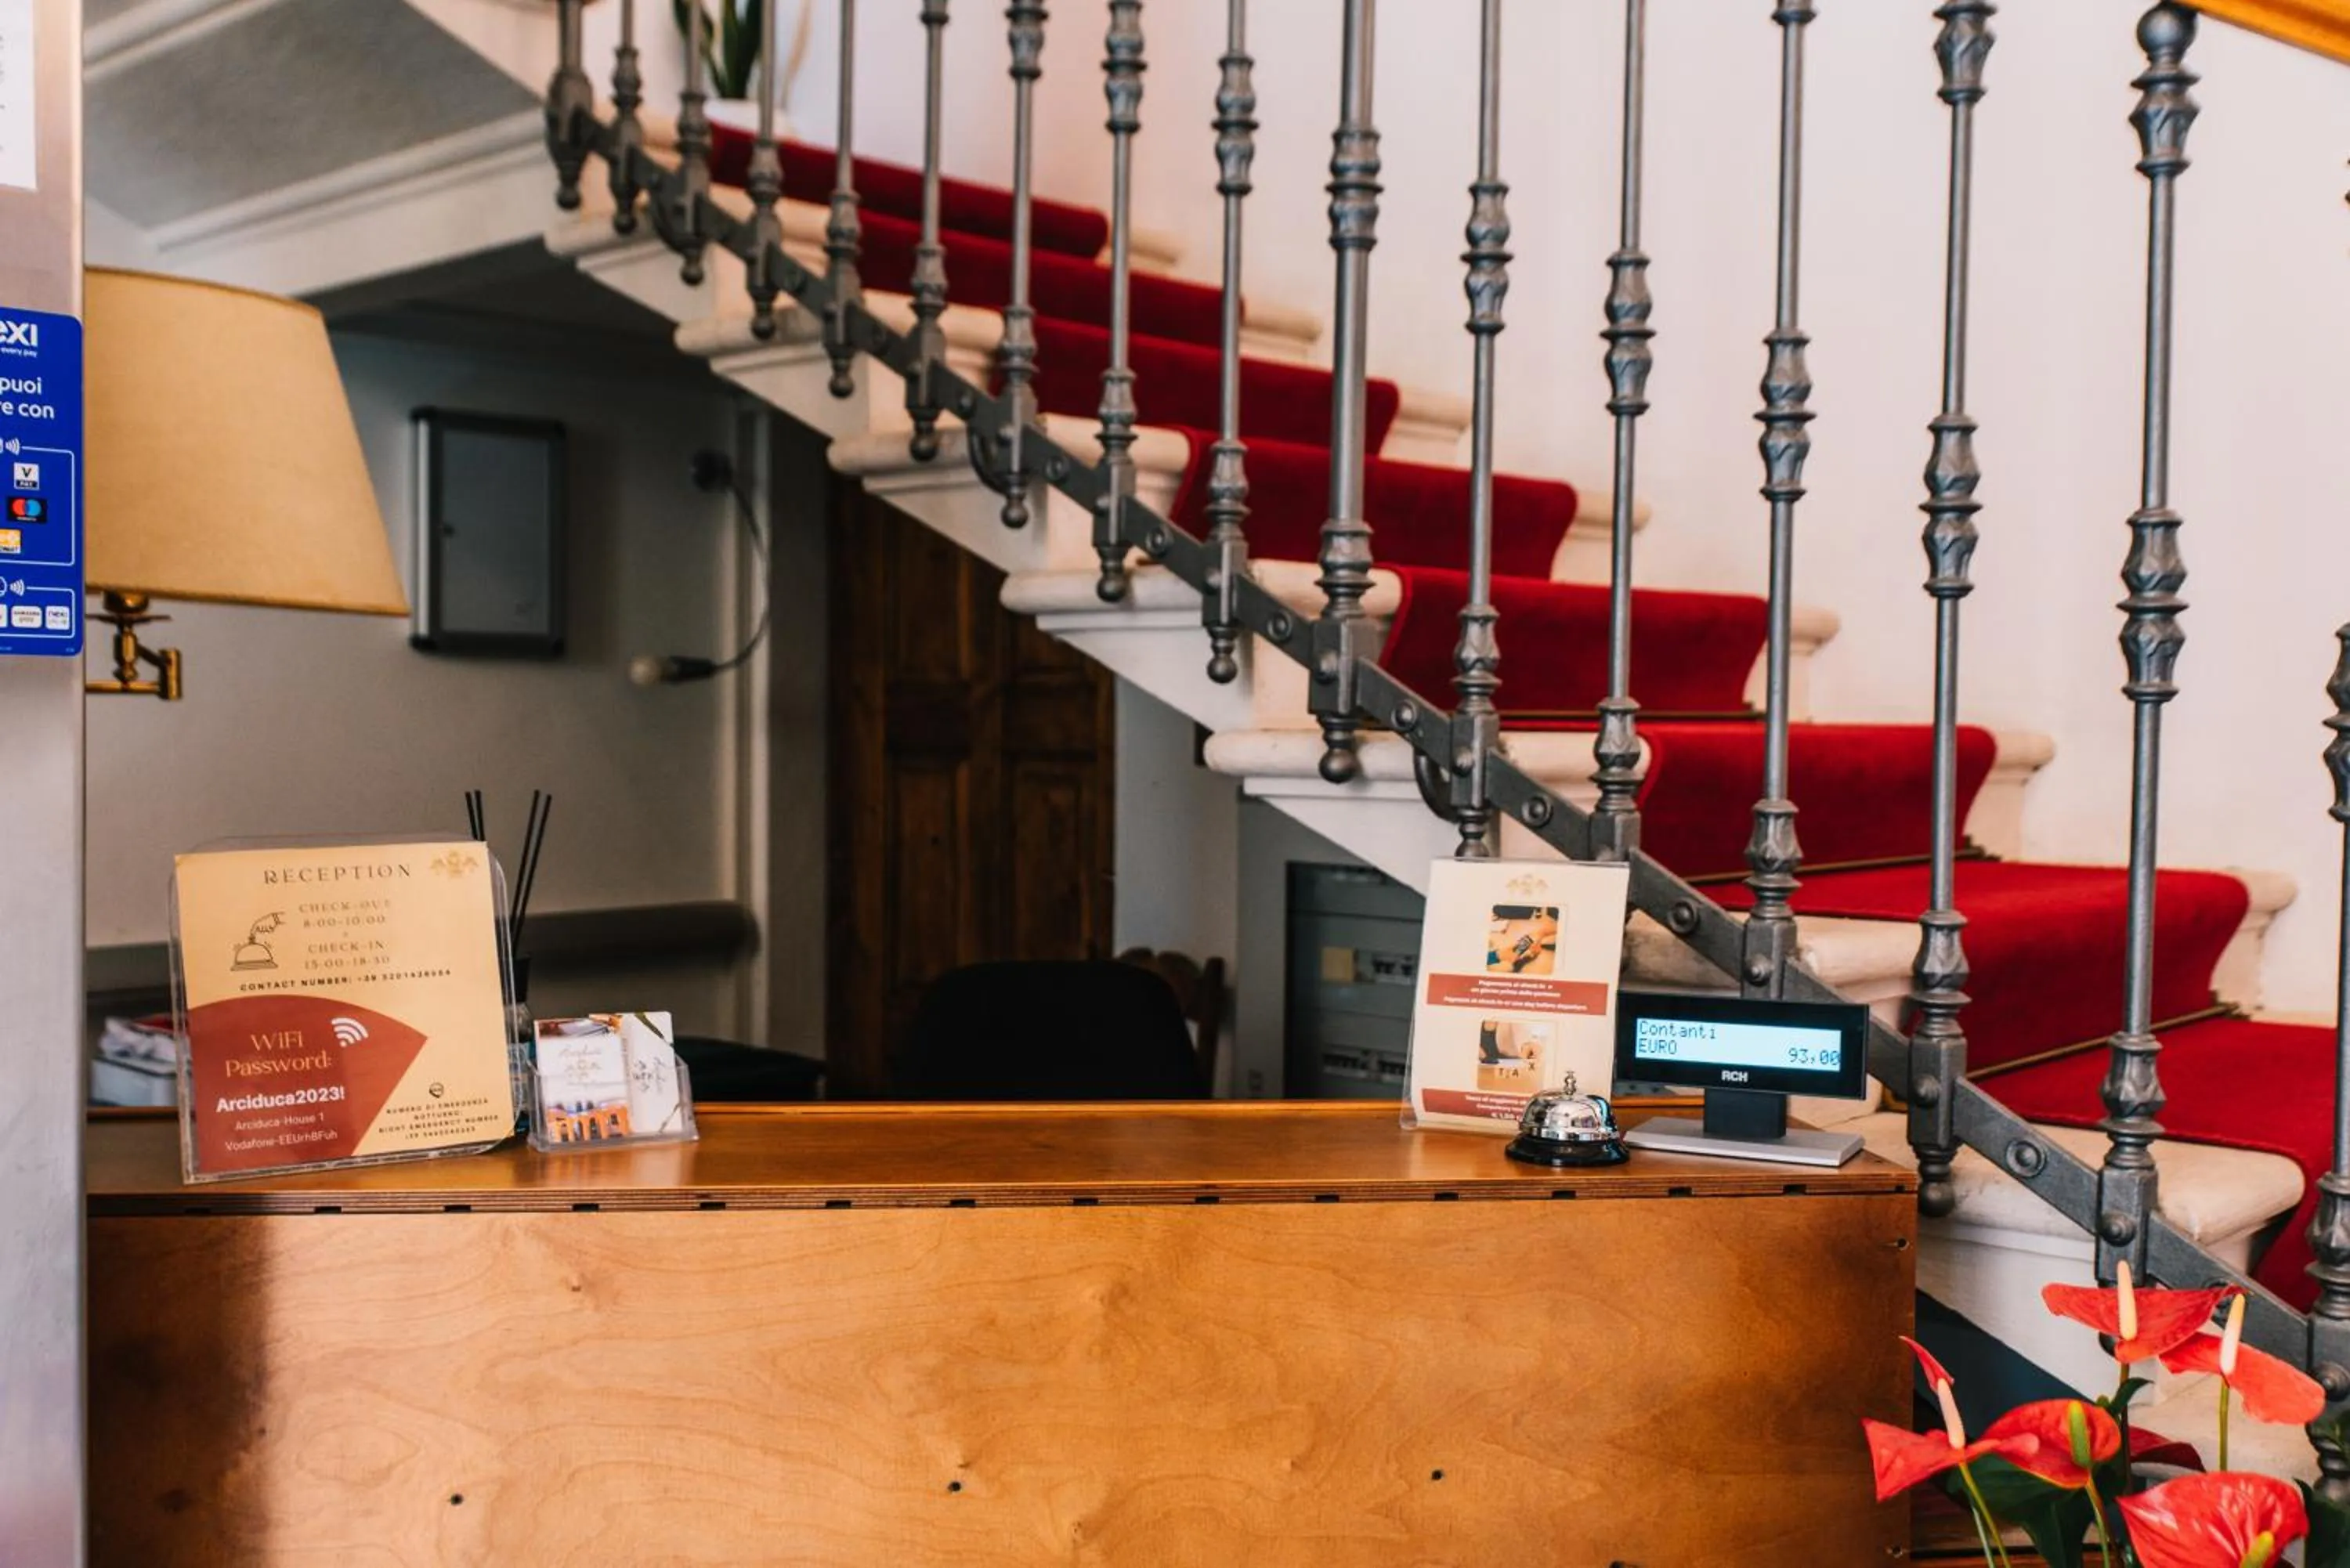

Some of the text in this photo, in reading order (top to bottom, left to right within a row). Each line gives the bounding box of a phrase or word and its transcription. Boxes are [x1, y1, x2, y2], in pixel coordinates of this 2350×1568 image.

[0, 400, 55, 420] e con
[264, 864, 411, 884] RECEPTION
[240, 981, 295, 992] CONTACT
[1640, 1021, 1716, 1039] Contanti
[1638, 1038, 1841, 1065] EURO 93,00
[225, 1050, 332, 1078] Password:
[1721, 1070, 1748, 1082] RCH
[215, 1086, 345, 1113] Arciduca2023!
[318, 1112, 324, 1122] 1
